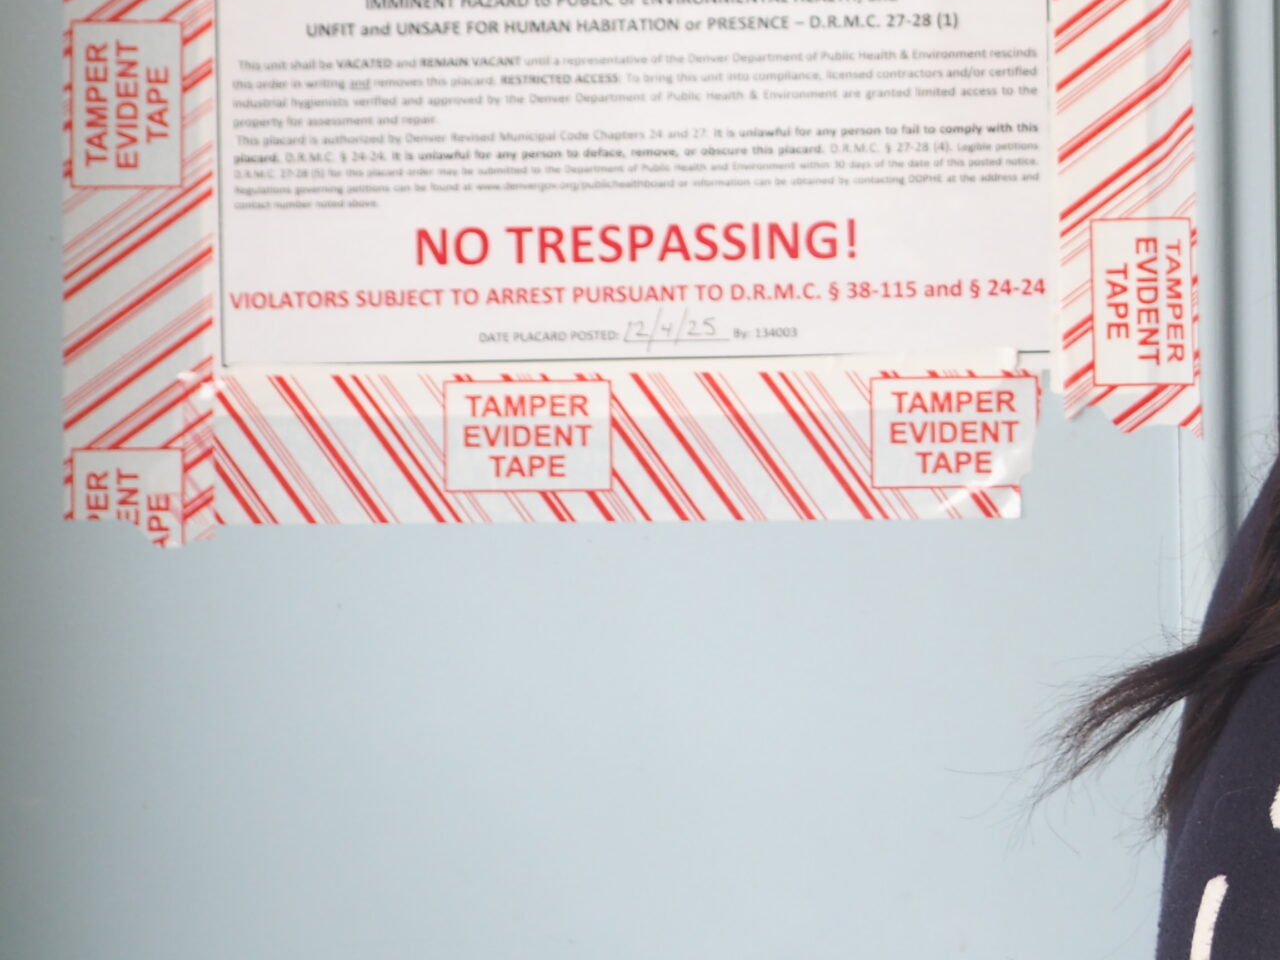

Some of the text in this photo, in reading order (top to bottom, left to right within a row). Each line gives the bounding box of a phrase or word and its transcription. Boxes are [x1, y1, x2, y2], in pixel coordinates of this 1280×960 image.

[306, 23, 355, 38] UNFIT
[360, 24, 390, 37] and
[396, 21, 461, 36] UNSAFE
[467, 20, 498, 35] FOR
[505, 20, 570, 34] HUMAN
[577, 18, 679, 33] HABITATION
[686, 20, 702, 32] or
[708, 16, 789, 31] PRESENCE
[810, 14, 880, 29] D.R.M.C.
[886, 13, 931, 28] 27-28
[937, 12, 958, 30] (1)
[85, 43, 108, 168] TAMPER
[116, 40, 139, 169] EVIDENT
[146, 67, 169, 143] TAPE
[415, 218, 858, 266] NO TRESPASSING!
[229, 291, 349, 310] VIOLATORS
[356, 289, 444, 308] SUBJECT
[453, 288, 478, 306] TO
[486, 287, 565, 305] ARREST
[573, 285, 687, 303] PURSUANT
[695, 284, 723, 302] TO
[731, 283, 821, 301] D.R.M.C.
[847, 281, 916, 299] 38-115
[924, 282, 961, 298] and
[988, 278, 1046, 296] 24-24
[1105, 262, 1130, 340] TAPE
[1135, 237, 1160, 366] EVIDENT
[1165, 239, 1185, 363] TAMPER
[479, 332, 509, 343] DATE
[513, 331, 567, 342] PLACARD
[570, 330, 619, 341] POSTED:
[734, 329, 751, 340] By:
[755, 328, 798, 339] 134003
[465, 394, 589, 418] TAMPER
[891, 390, 1017, 414] TAMPER
[463, 424, 593, 449] EVIDENT
[889, 420, 1020, 445] EVIDENT
[488, 454, 567, 478] TAPE
[915, 451, 993, 475] TAPE
